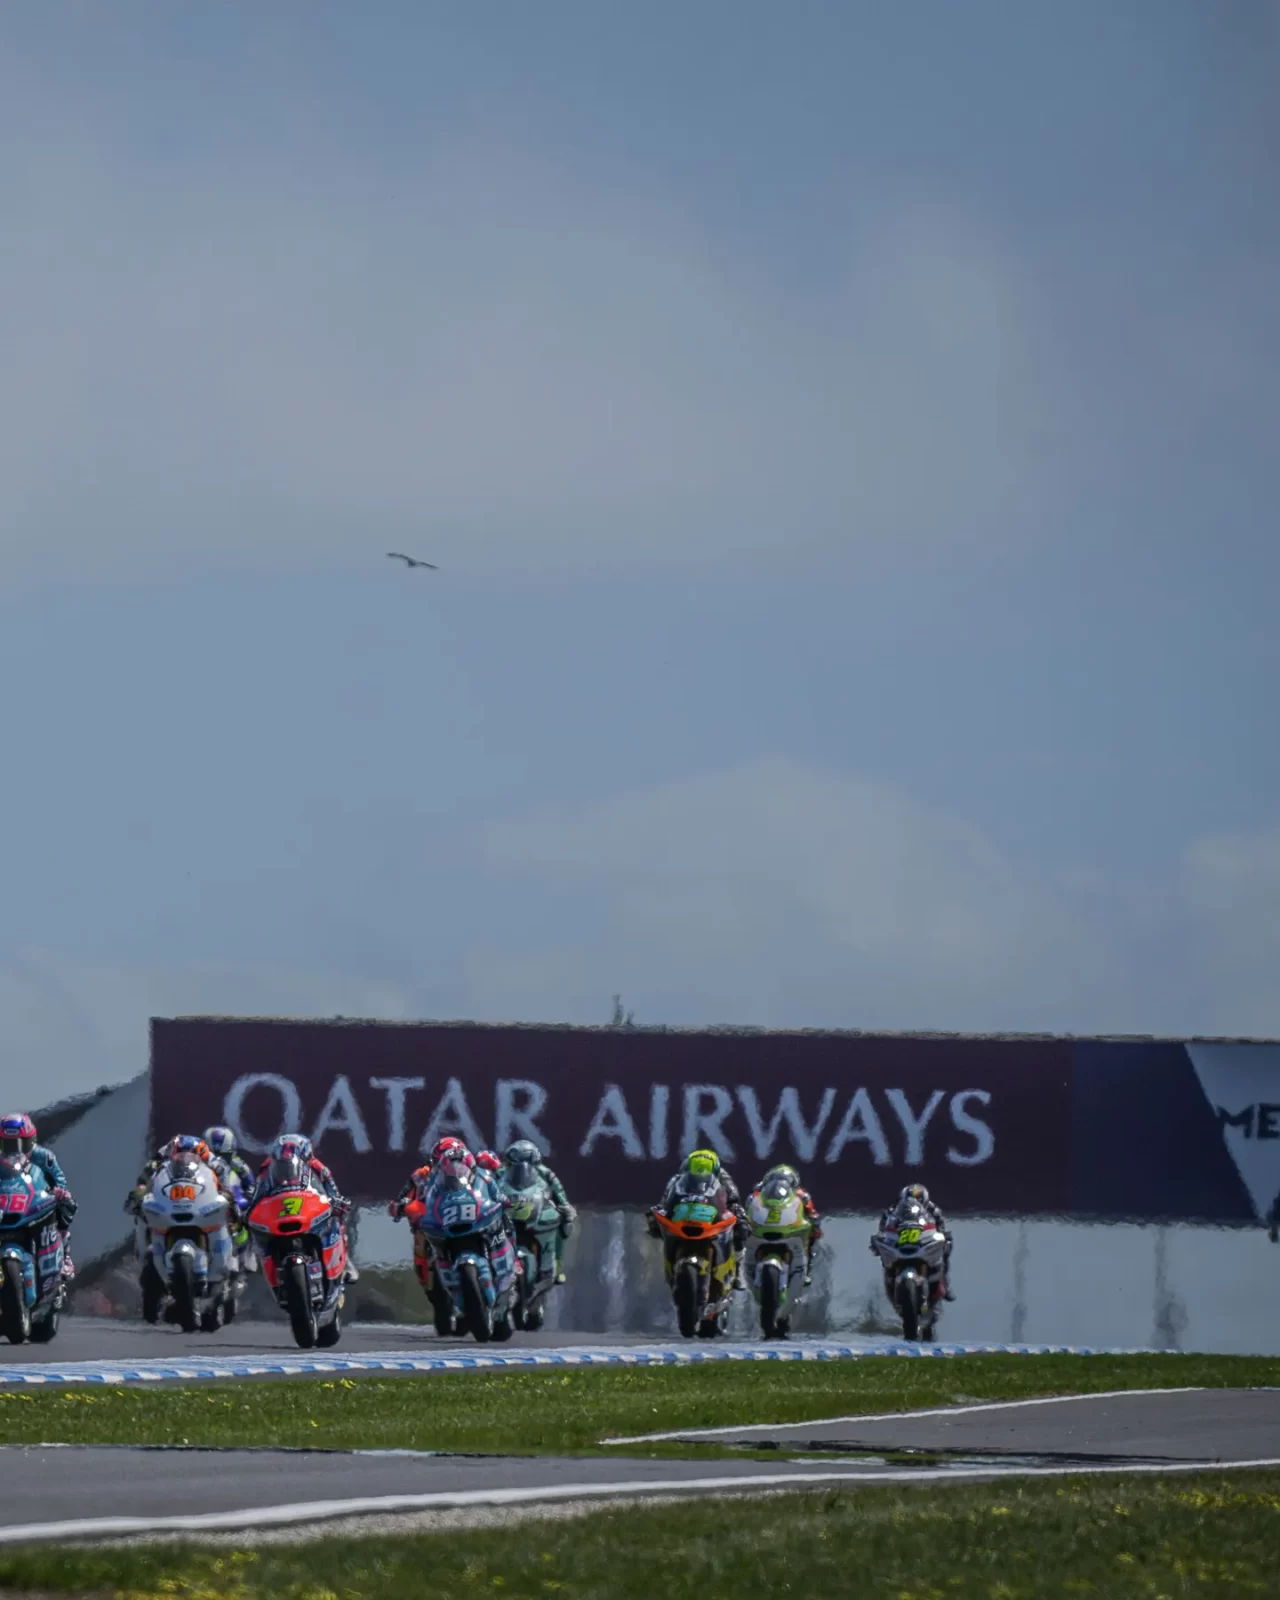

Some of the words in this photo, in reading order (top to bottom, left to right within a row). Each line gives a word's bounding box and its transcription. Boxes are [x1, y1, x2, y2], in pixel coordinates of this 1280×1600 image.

[579, 1083, 995, 1167] AIRWAYS
[279, 1197, 304, 1217] 3
[442, 1203, 476, 1226] 28
[898, 1228, 921, 1245] 20
